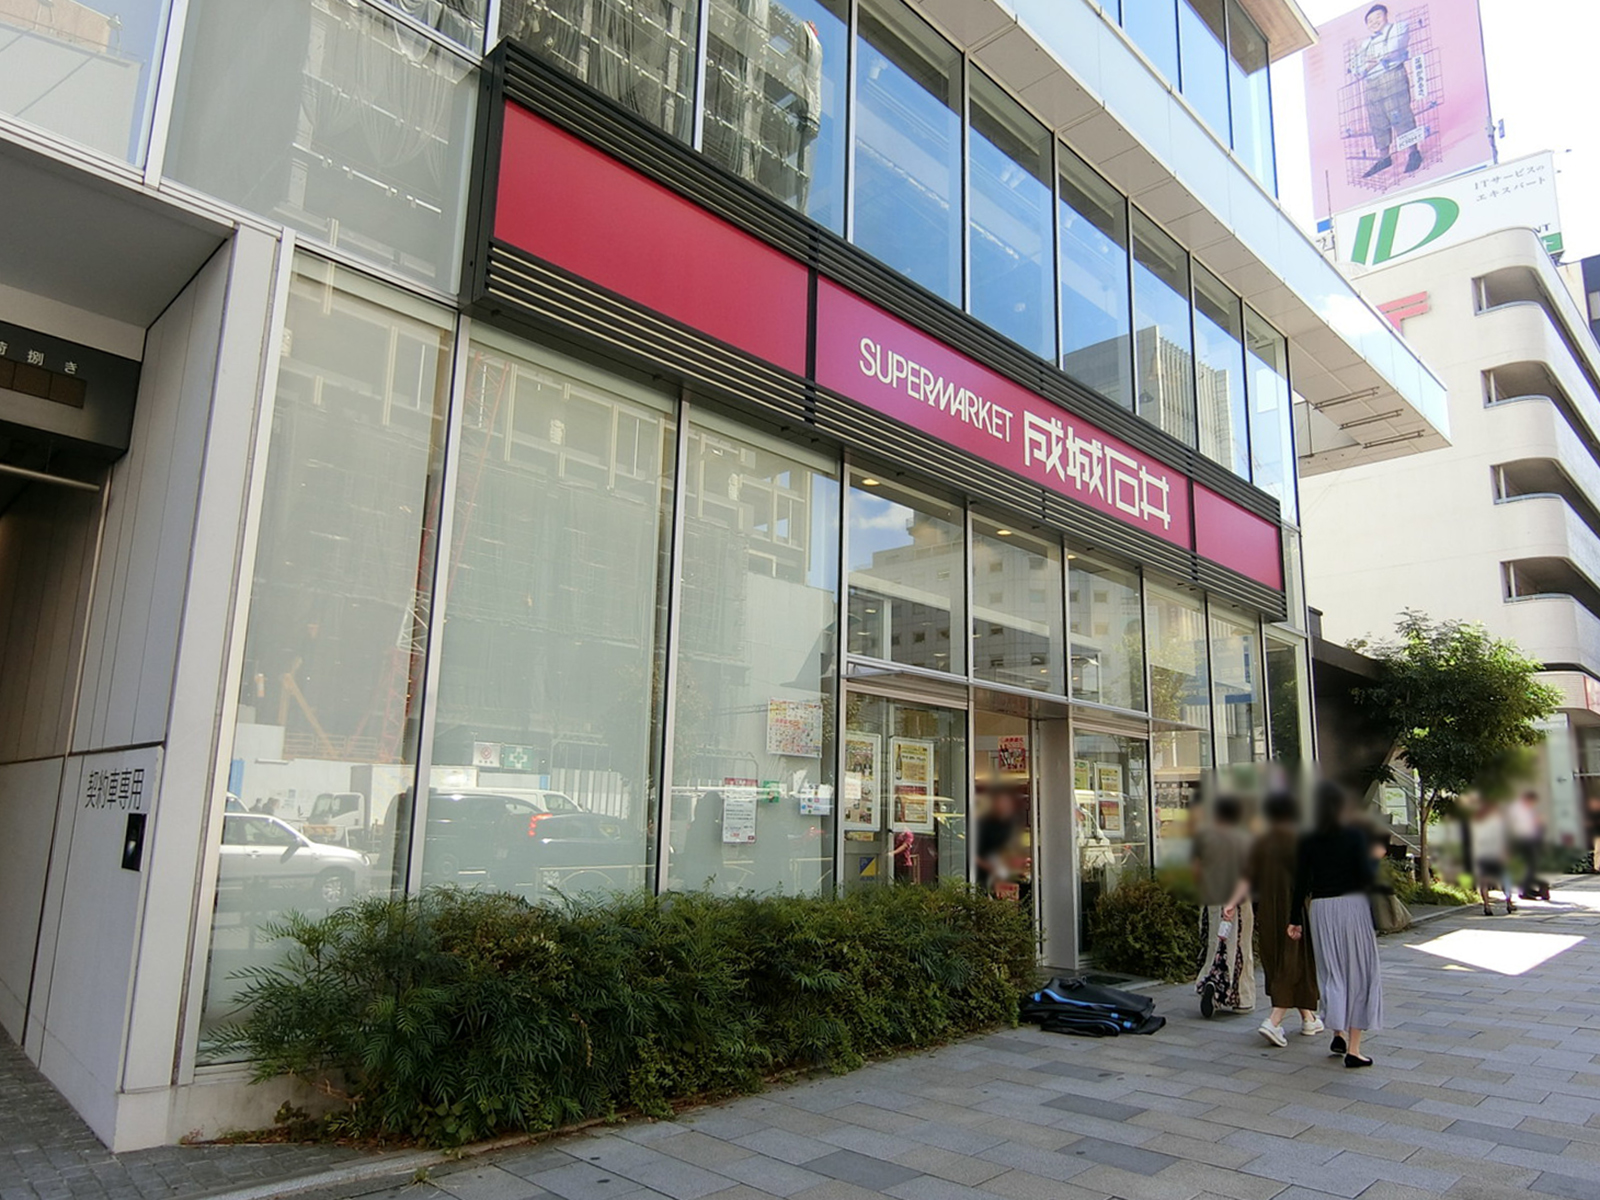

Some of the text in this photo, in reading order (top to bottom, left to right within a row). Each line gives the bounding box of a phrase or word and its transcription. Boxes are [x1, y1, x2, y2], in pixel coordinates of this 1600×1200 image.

[1351, 196, 1460, 266] ID
[858, 337, 1014, 443] SUPERMARKET
[1022, 410, 1172, 531] 成城石井
[85, 768, 145, 810] 契約車専用
